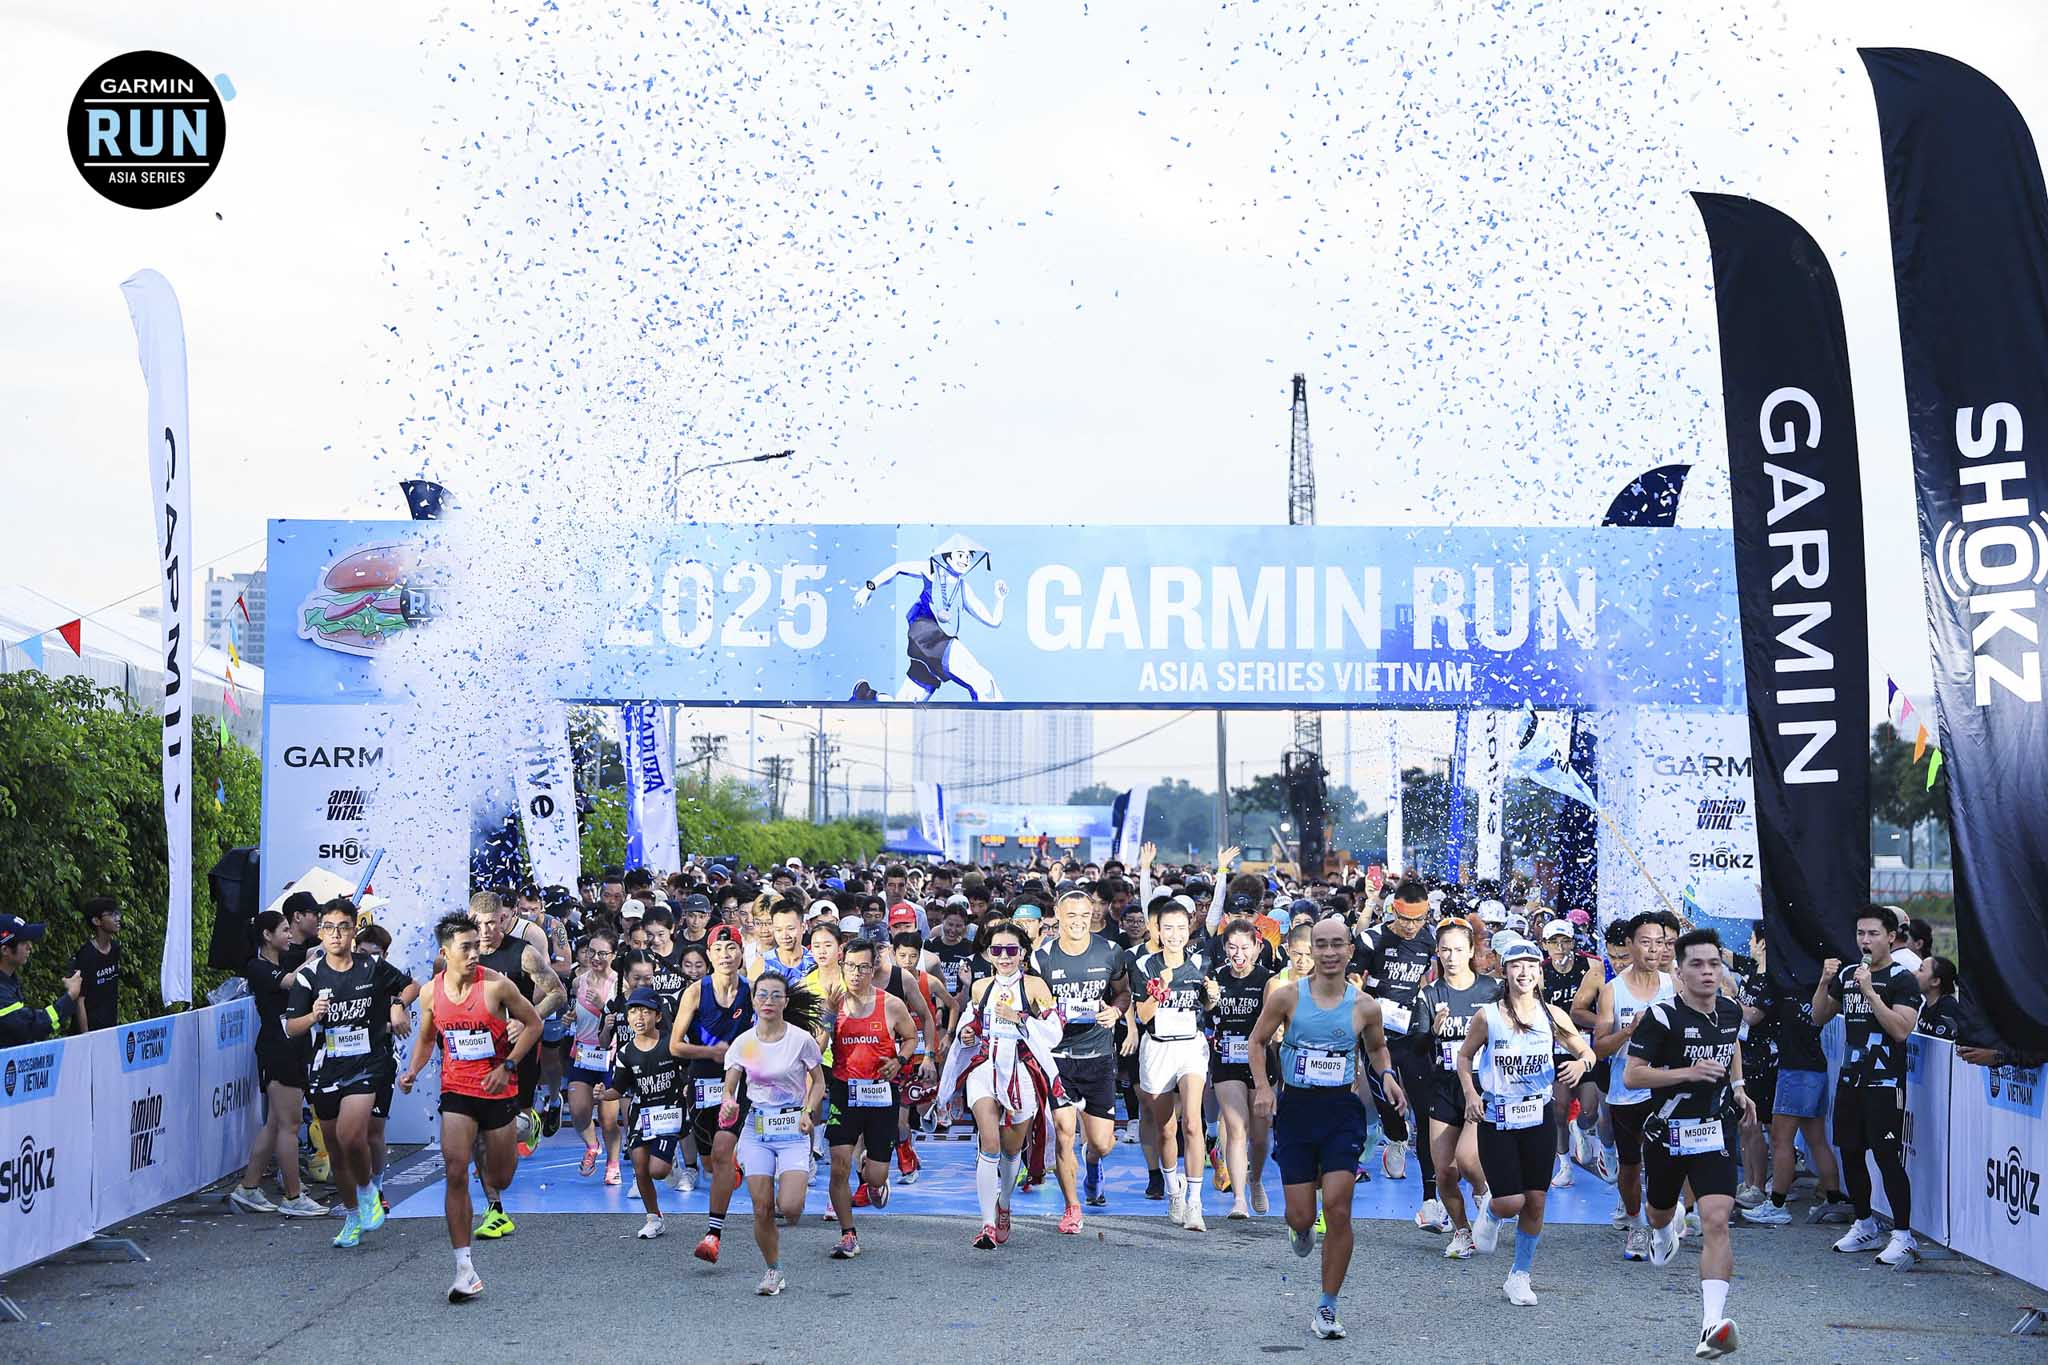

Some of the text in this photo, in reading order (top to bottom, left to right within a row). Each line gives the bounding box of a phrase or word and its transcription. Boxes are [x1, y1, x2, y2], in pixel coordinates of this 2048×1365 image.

[1946, 402, 2044, 706] SHOKZ
[1759, 387, 1839, 785] GARMIN
[602, 560, 828, 649] 2025
[1026, 564, 1598, 651] GARMIN RUN
[1138, 661, 1472, 692] ASIA SERIES VIETNAM
[283, 746, 383, 768] GARM
[1653, 755, 1750, 777] GARM
[1696, 814, 1733, 830] VITAL
[319, 841, 371, 862] SHOK
[1689, 851, 1753, 868] SHOKZ
[1052, 980, 1106, 994] FROM ZERO
[349, 996, 372, 1013] ZERO
[1239, 997, 1258, 1008] ZERO
[328, 1011, 339, 1022] TO
[842, 1036, 879, 1045] UDAQUA
[1494, 1053, 1548, 1067] FROM ZERO
[1683, 1045, 1713, 1057] FROM
[1310, 1061, 1341, 1071] M50075
[1503, 1065, 1541, 1076] TO HERO
[212, 1077, 250, 1118] GARMIN
[861, 1087, 887, 1095] M50104
[2007, 1082, 2033, 1106] VIETNAM
[130, 1088, 162, 1134] amino
[1512, 1105, 1537, 1114] F50175
[1684, 1126, 1717, 1138] M50072
[130, 1131, 154, 1173] VITAL
[0, 1141, 56, 1208] SHOKZ
[1986, 1152, 2040, 1221] SHOKZ
